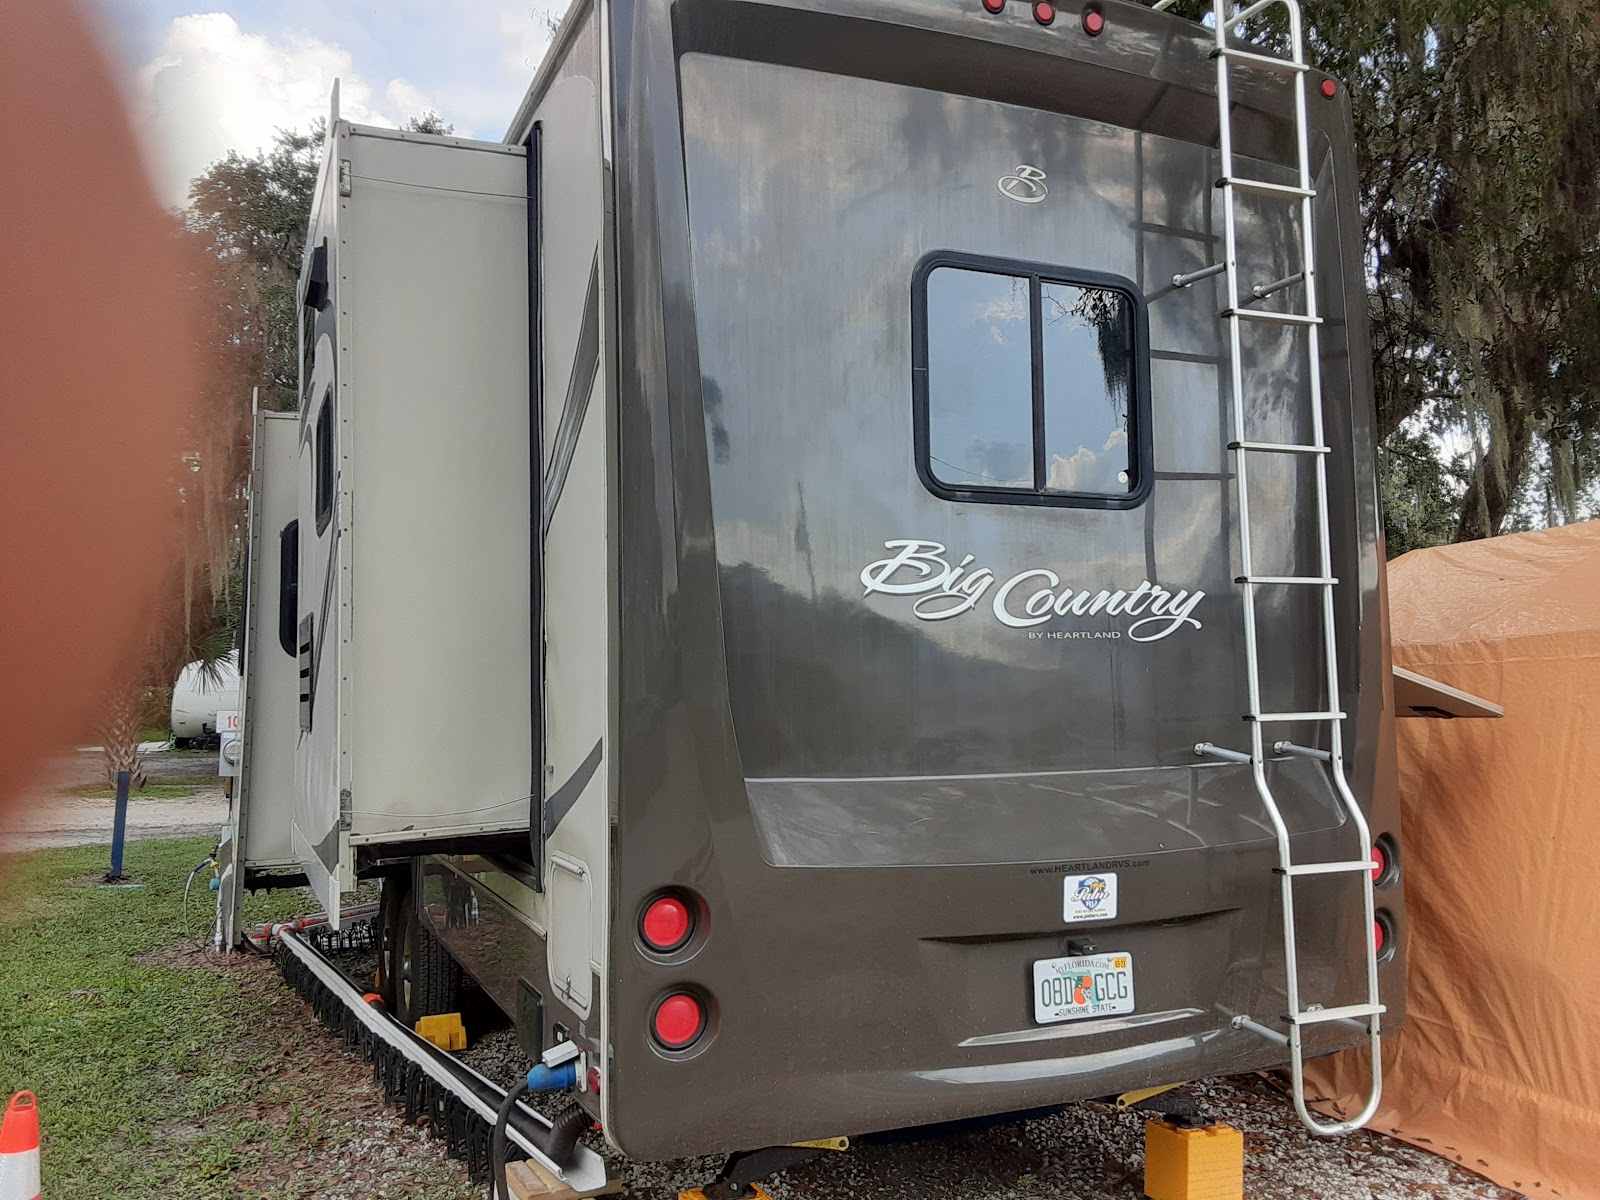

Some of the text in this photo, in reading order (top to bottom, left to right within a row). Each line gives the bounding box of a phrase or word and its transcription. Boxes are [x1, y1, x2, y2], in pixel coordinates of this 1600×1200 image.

[860, 539, 1206, 642] Big Country
[1028, 631, 1121, 639] BY HEARTLAND
[1029, 859, 1151, 875] www.HEARTLANDRVS.com
[1071, 886, 1110, 902] Palm
[1085, 900, 1098, 909] RV
[1055, 959, 1110, 975] MYFLORIDA.COM
[1094, 971, 1128, 1002] GCG
[1058, 1002, 1113, 1017] SUNSHINE STATE
